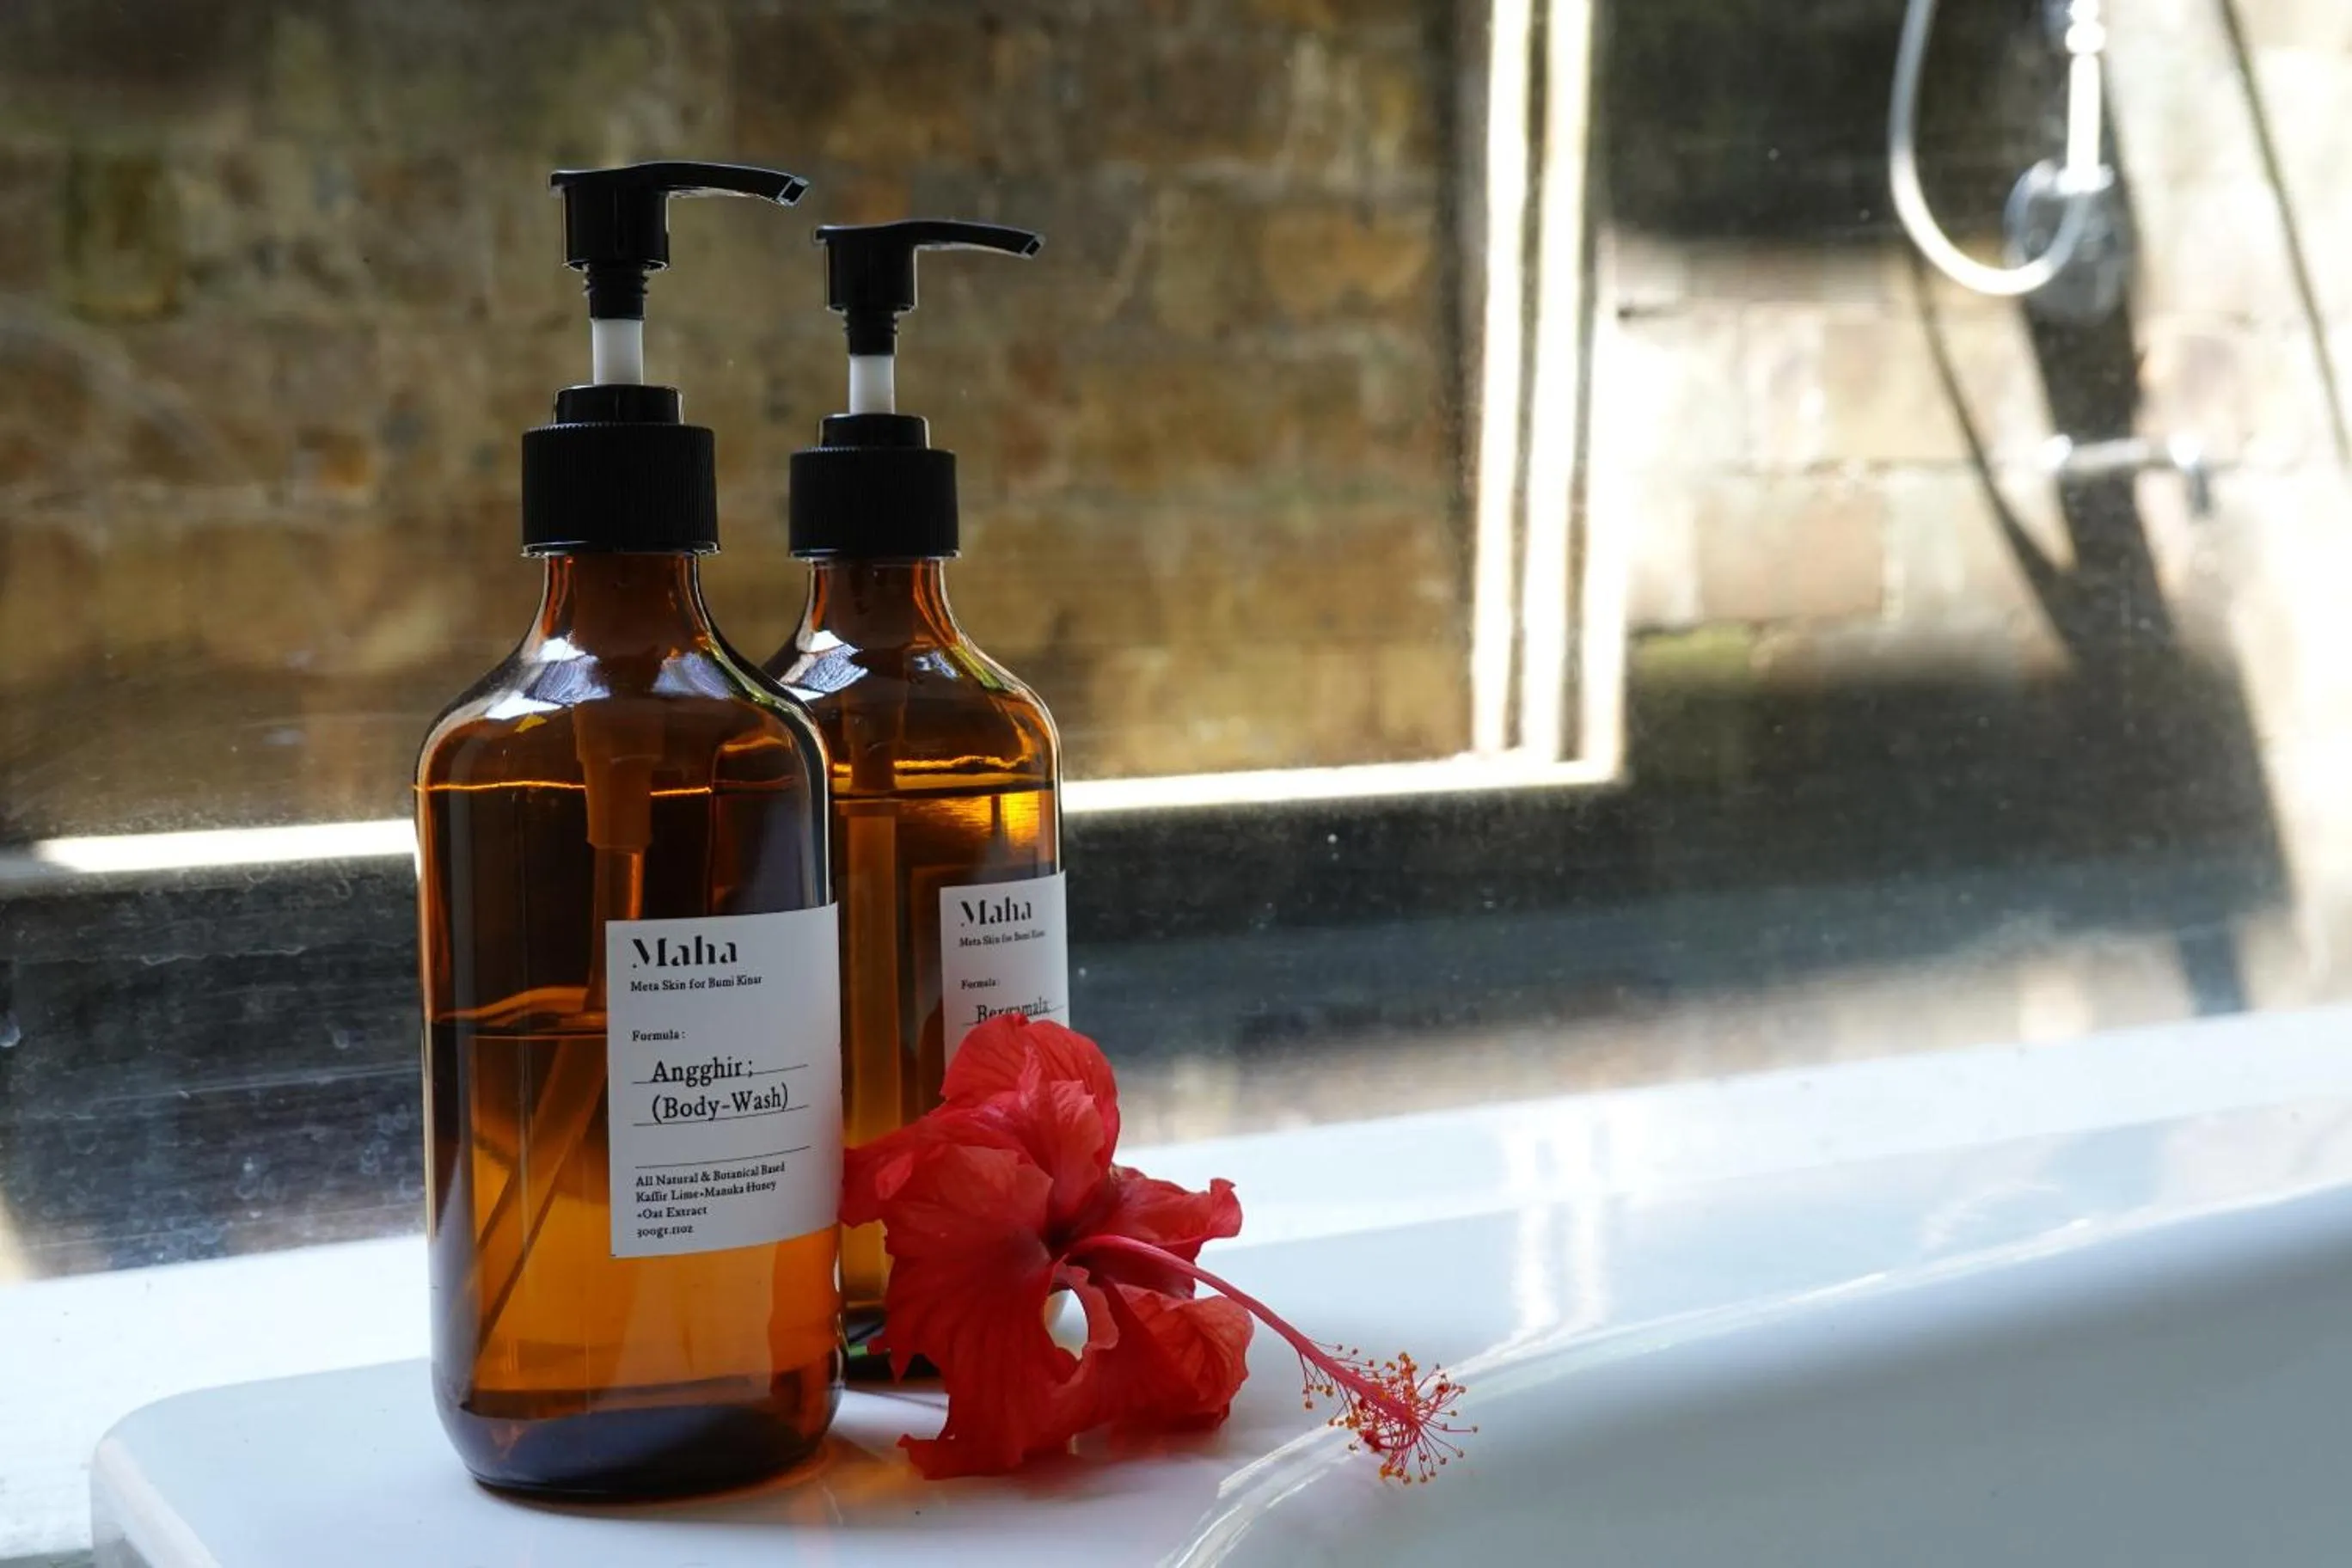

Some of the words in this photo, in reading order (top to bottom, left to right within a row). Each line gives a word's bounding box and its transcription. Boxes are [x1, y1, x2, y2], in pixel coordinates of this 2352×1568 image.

[960, 897, 1032, 927] Maha
[632, 934, 738, 969] Maha
[630, 980, 659, 992] Meta
[662, 978, 686, 991] Skin
[689, 977, 705, 989] for
[707, 975, 734, 988] Bumi
[652, 1082, 788, 1124] (Body-Wash)
[635, 1175, 653, 1187] All
[656, 1173, 699, 1185] Natural
[701, 1171, 711, 1182] &
[713, 1167, 759, 1181] Botanical
[761, 1161, 785, 1176] Based
[635, 1191, 668, 1203] Kaffir
[746, 1180, 777, 1193] Honey
[666, 1206, 707, 1218] Extract
